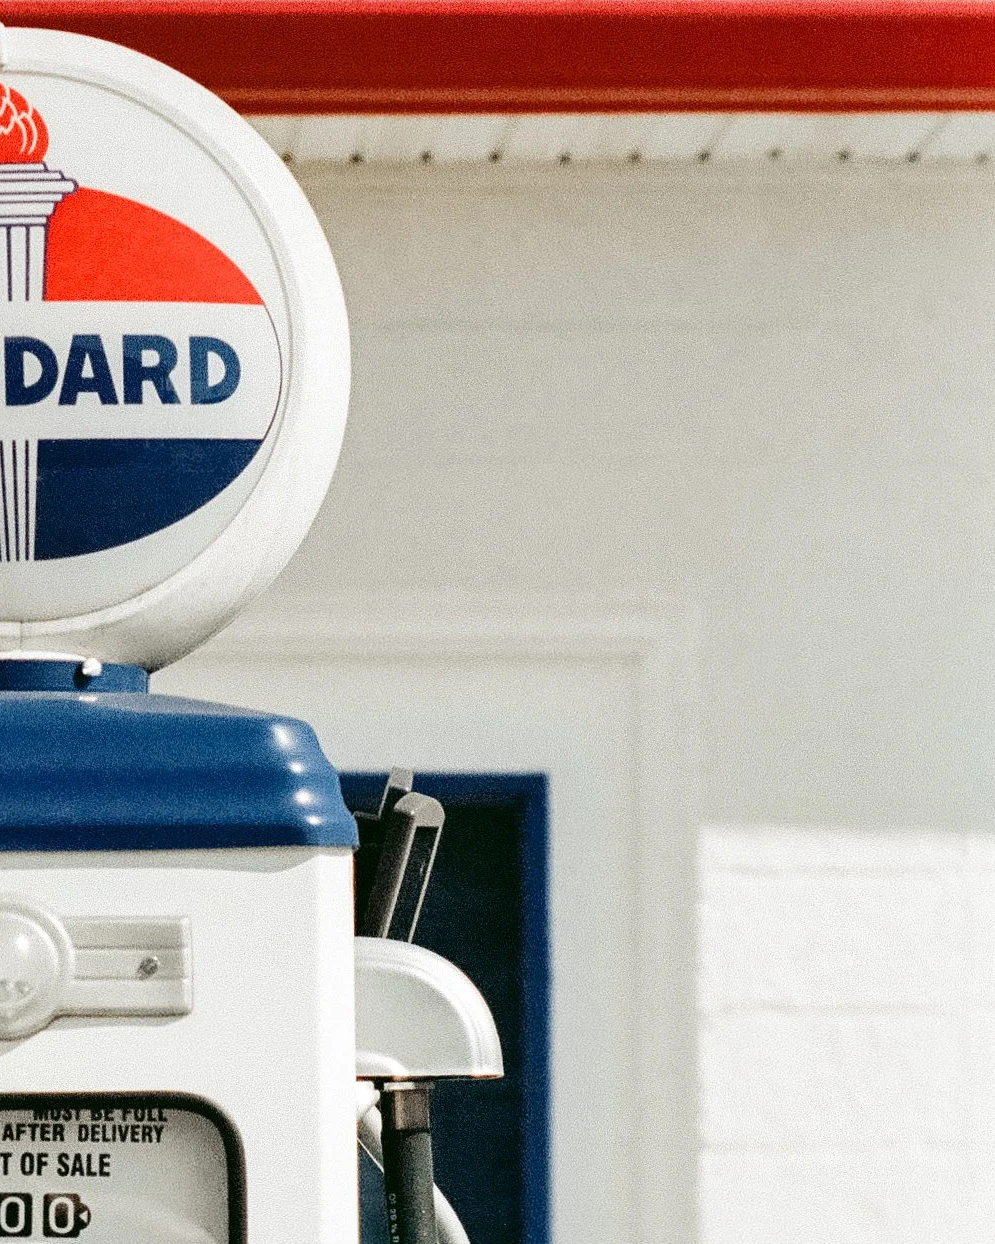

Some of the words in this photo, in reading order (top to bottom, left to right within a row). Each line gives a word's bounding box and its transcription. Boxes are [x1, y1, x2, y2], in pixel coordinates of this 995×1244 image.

[3, 1123, 64, 1141] AFTER
[78, 1124, 164, 1142] DELIVERY
[21, 1152, 48, 1175] OF
[57, 1153, 110, 1176] SALE
